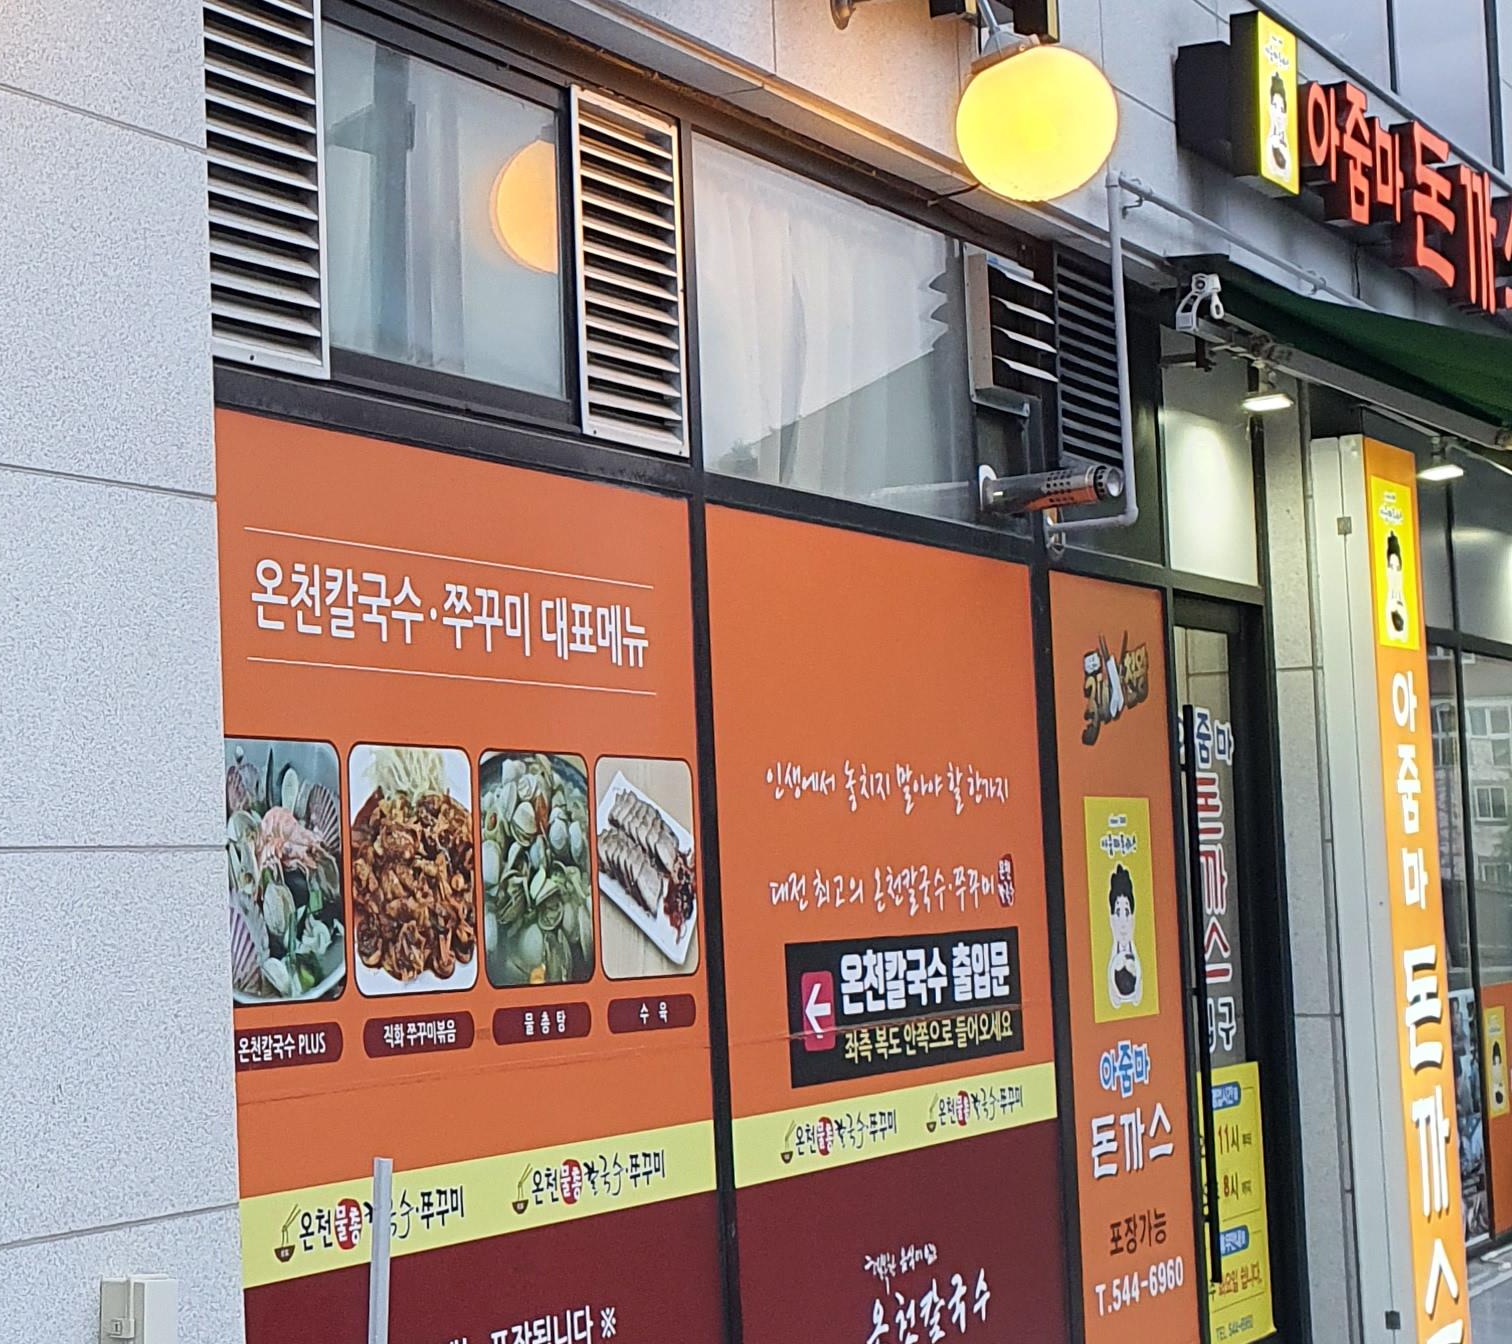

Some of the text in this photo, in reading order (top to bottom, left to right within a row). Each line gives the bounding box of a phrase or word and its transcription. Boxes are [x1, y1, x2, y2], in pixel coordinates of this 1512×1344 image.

[1306, 80, 1512, 316] 아줌마 돈까
[540, 596, 650, 668] 대표메뉴
[766, 761, 836, 800] 인생에서
[895, 763, 944, 816] 말아야
[946, 761, 965, 816] 할
[967, 764, 1010, 804] 한가지
[1391, 670, 1429, 909] 아줌마
[768, 871, 809, 912] 대전
[812, 868, 865, 908] 최고의
[840, 940, 1011, 1016] 온천칼국수 출입문
[238, 1031, 327, 1064] 온천칼국수 PLUS
[383, 1022, 405, 1048] 직화
[844, 1010, 1014, 1064] 좌측 복도 안쪽으로 들어오세요
[1100, 1040, 1150, 1098] 아줌마
[1091, 1102, 1174, 1179] 돈까스
[531, 1167, 560, 1206] 온천
[299, 1207, 333, 1252] 온천
[1110, 1207, 1167, 1256] 포장가능
[1095, 1255, 1184, 1317] T.544-6960
